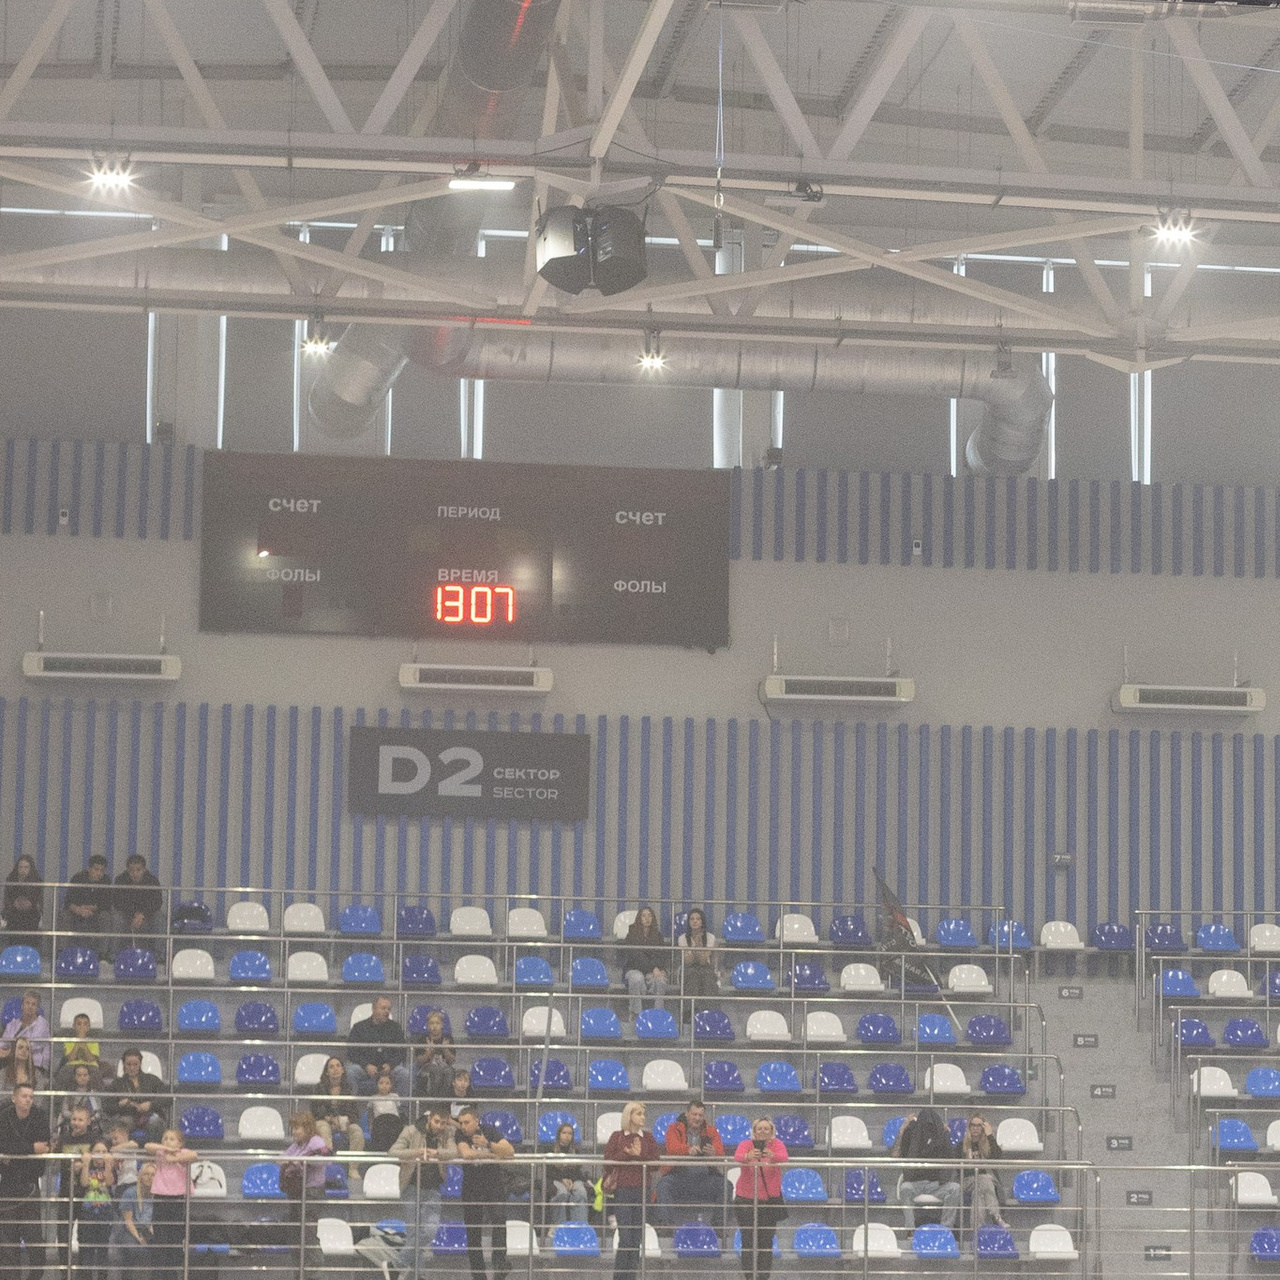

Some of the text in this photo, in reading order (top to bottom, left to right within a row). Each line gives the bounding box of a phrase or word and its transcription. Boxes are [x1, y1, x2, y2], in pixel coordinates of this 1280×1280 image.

[437, 505, 501, 521] ПЕРИОД
[266, 568, 321, 583] ФОЛЫ
[437, 568, 499, 584] ВРЕМЯ
[613, 579, 667, 594] ФОЛЫ
[378, 744, 486, 798] D2
[493, 767, 561, 782] СЕКТОР
[493, 786, 560, 801] SECTOR
[1061, 988, 1070, 998] 6
[1094, 1088, 1102, 1097] 4
[1130, 1194, 1138, 1203] 2
